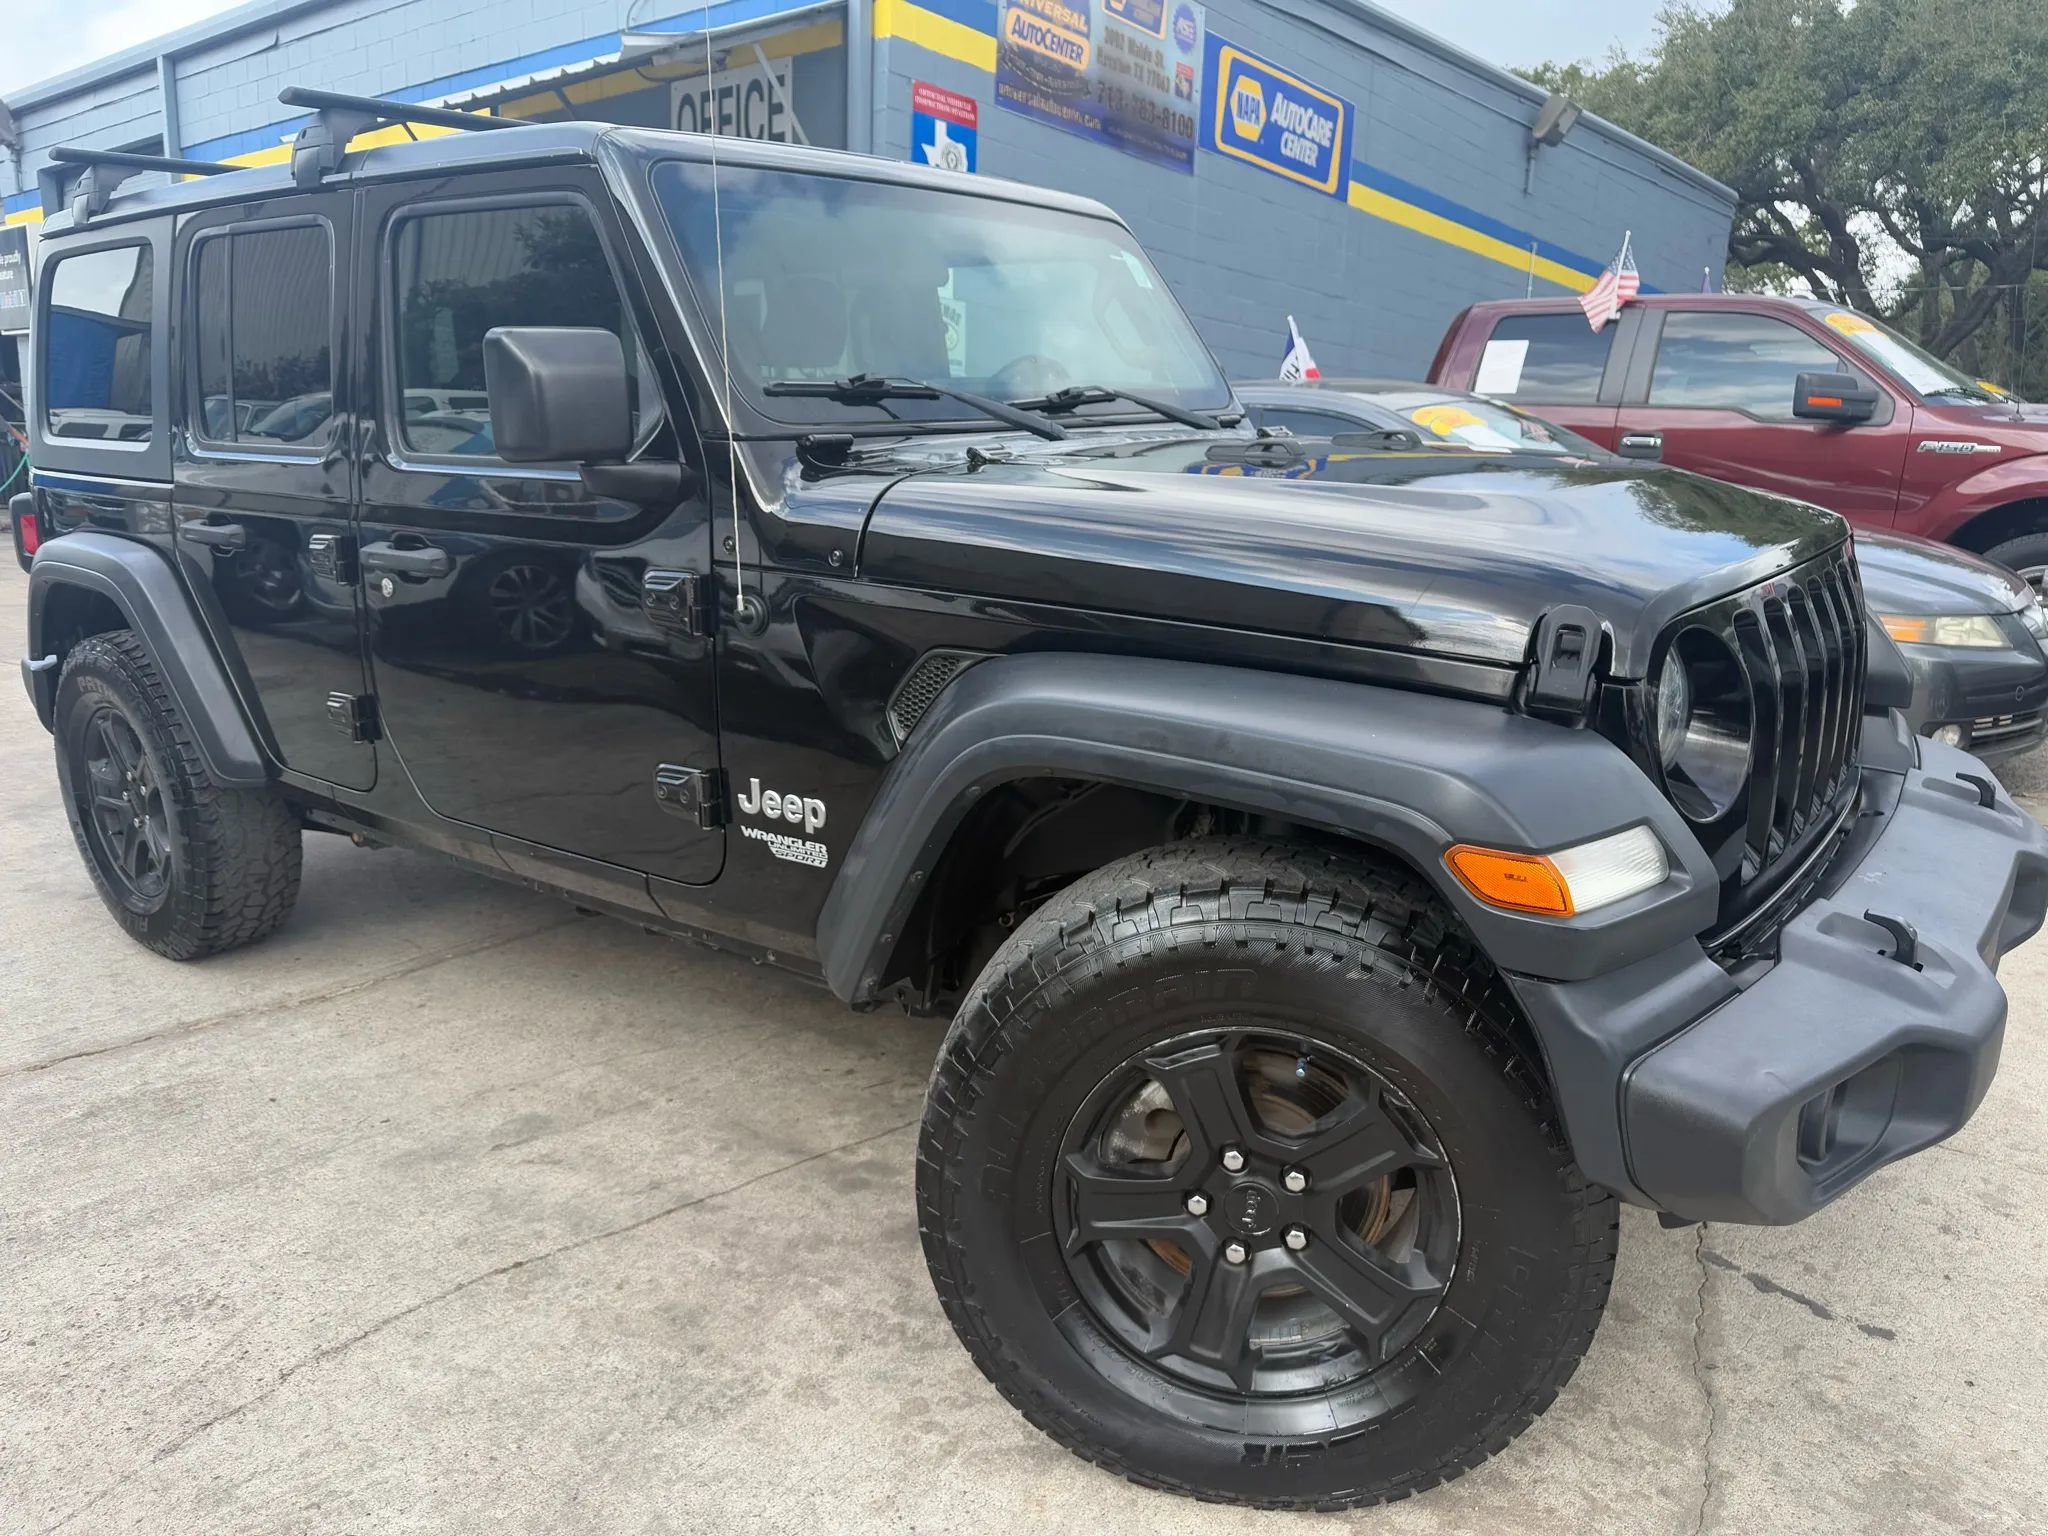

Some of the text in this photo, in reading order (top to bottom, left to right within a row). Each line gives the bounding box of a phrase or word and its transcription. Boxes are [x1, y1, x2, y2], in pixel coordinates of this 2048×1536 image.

[1011, 14, 1084, 64] AUTOCENTER
[677, 75, 785, 142] OFFICE
[1237, 91, 1261, 128] NAPA
[1270, 92, 1333, 148] AUTOCARE
[1280, 131, 1319, 168] CENTER
[737, 777, 827, 834] Jeep
[740, 825, 828, 854] WRANGLER
[767, 841, 828, 859] UNLIMITED
[774, 849, 826, 866] SPORT
